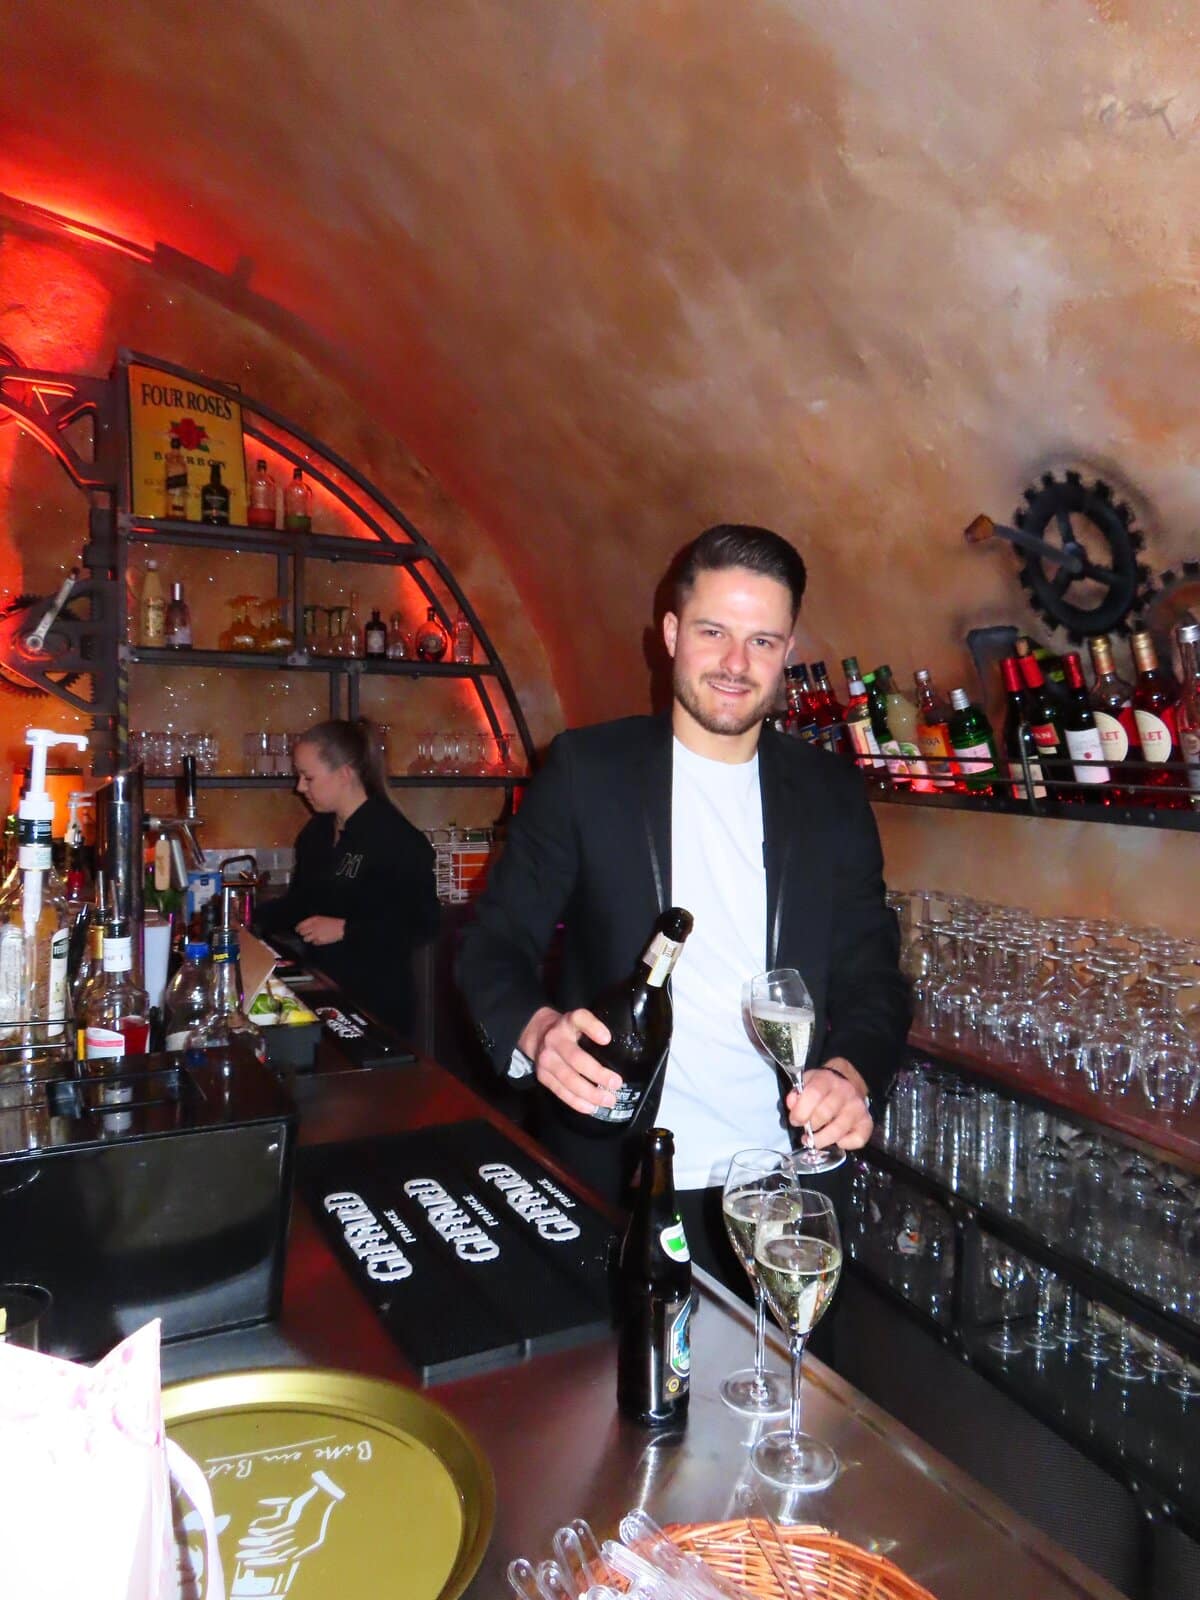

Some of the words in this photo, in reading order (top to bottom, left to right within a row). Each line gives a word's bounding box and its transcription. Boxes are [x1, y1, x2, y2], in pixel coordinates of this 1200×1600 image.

[142, 384, 184, 408] FOUR
[187, 392, 232, 420] ROSES
[462, 1194, 499, 1227] FRANCE
[479, 1163, 581, 1242] GIFFARD
[536, 1178, 576, 1208] FRANCE
[323, 1191, 413, 1282] GIFFARD
[383, 1209, 417, 1244] FRANCE
[403, 1178, 500, 1263] GIFFARD
[264, 1452, 303, 1464] ein
